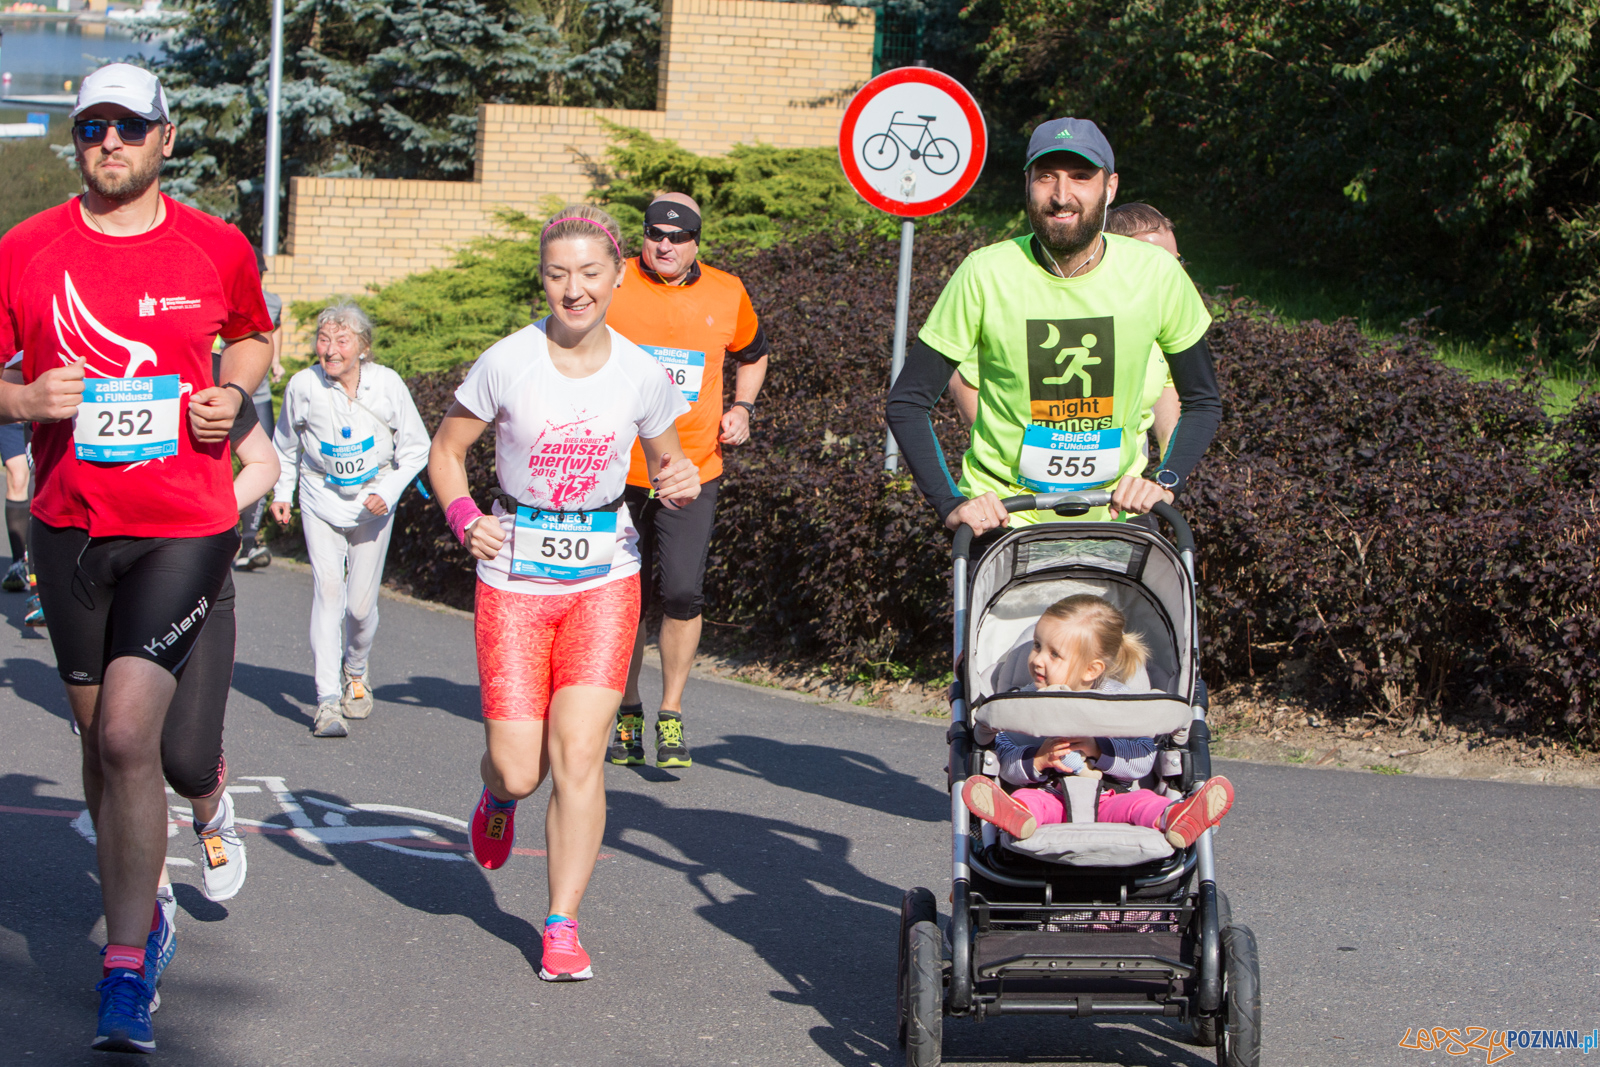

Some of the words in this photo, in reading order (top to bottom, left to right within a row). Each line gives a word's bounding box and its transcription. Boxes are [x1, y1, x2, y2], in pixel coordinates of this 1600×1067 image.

[159, 297, 169, 311] 1
[653, 349, 690, 360] zaBIEGaj
[95, 379, 153, 393] zaBIEGaj
[95, 394, 104, 402] o
[104, 393, 153, 402] FUNdusze
[1049, 398, 1100, 417] night
[97, 408, 153, 437] 252
[1051, 431, 1101, 443] zaBIEGaj
[541, 443, 609, 457] zawsze
[1058, 442, 1100, 450] FUNdusze
[335, 458, 365, 474] 002
[531, 468, 557, 478] 2016
[1046, 455, 1097, 478] 555
[549, 523, 593, 531] FUNdusze
[541, 536, 590, 560] 530
[143, 595, 209, 657] Kalenji
[491, 817, 504, 839] 530
